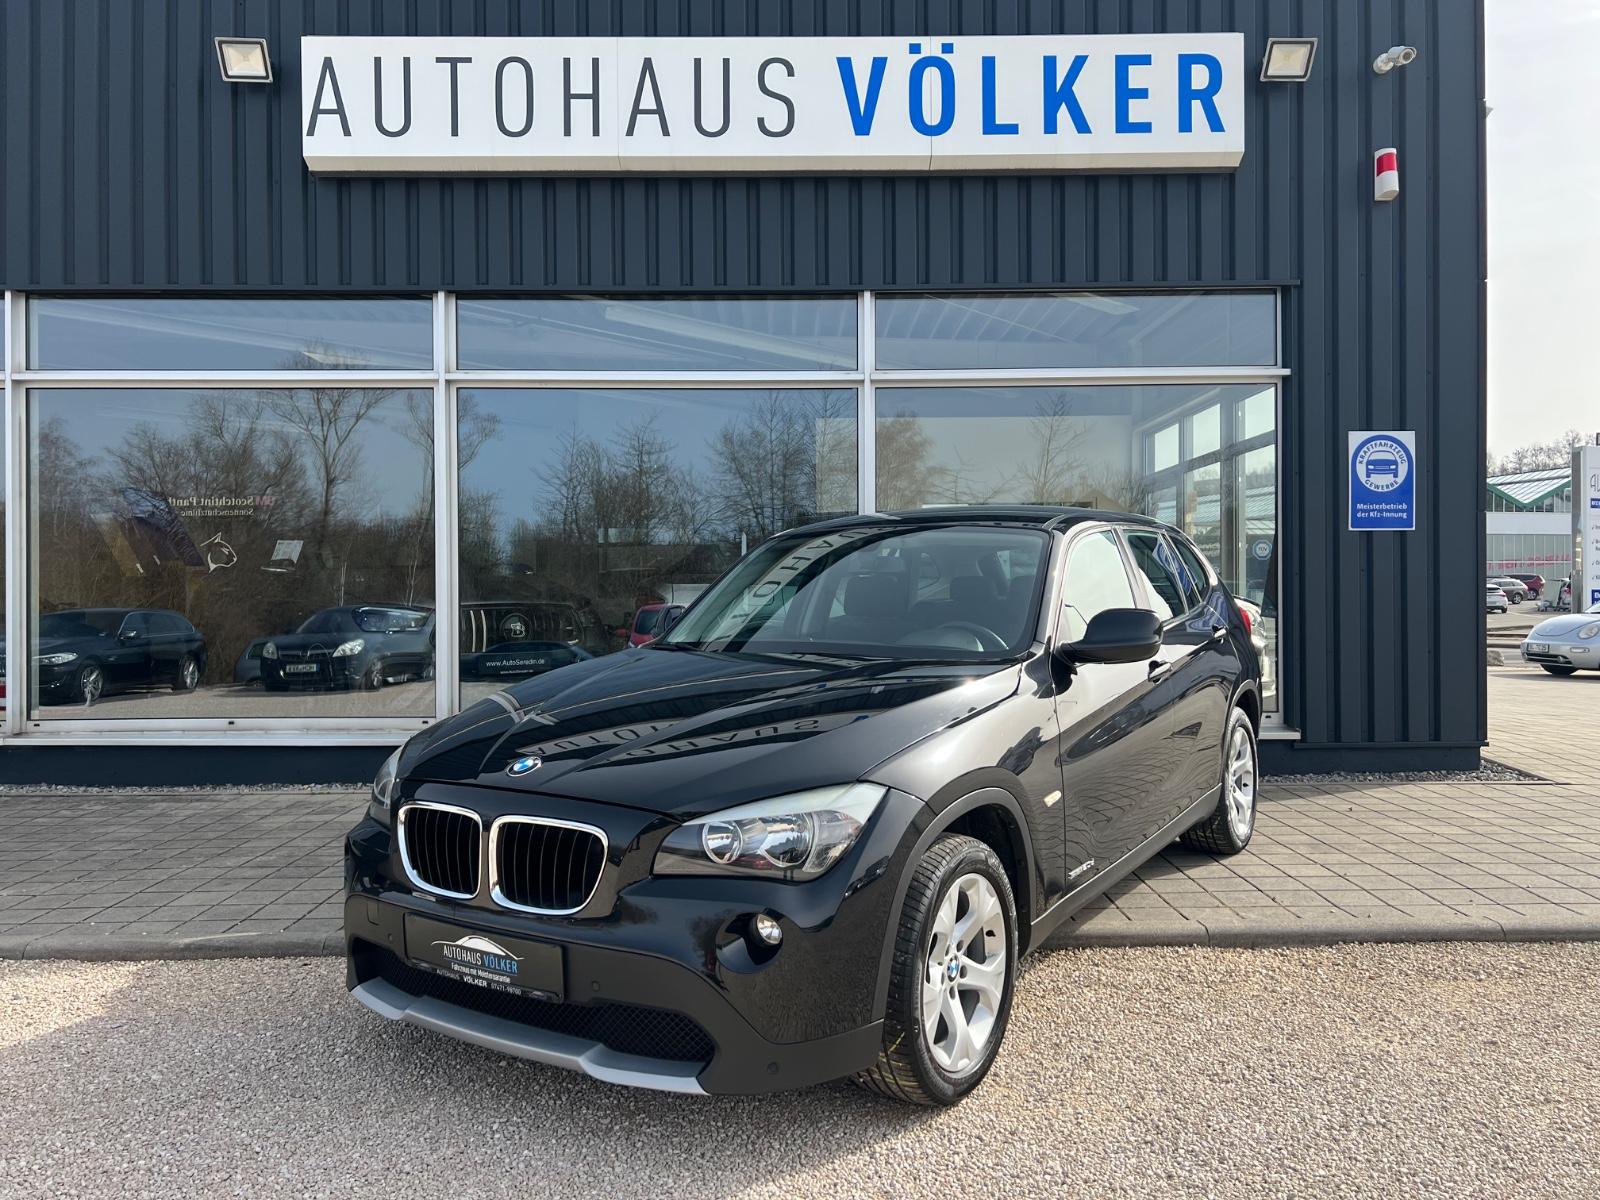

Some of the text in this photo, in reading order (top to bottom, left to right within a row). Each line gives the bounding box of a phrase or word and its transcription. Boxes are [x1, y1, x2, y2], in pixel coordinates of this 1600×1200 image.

[306, 44, 1226, 137] AUTOHAUS VÖLKER
[1358, 441, 1407, 465] KRAFTFAHRZEUG
[1365, 480, 1399, 490] GEWERBE
[1356, 502, 1408, 510] Meisterbetrieb
[1369, 511, 1408, 519] Kfz-Innung
[443, 944, 517, 973] AUTOHAUS VÖLKER
[463, 976, 487, 987] VÖLKER
